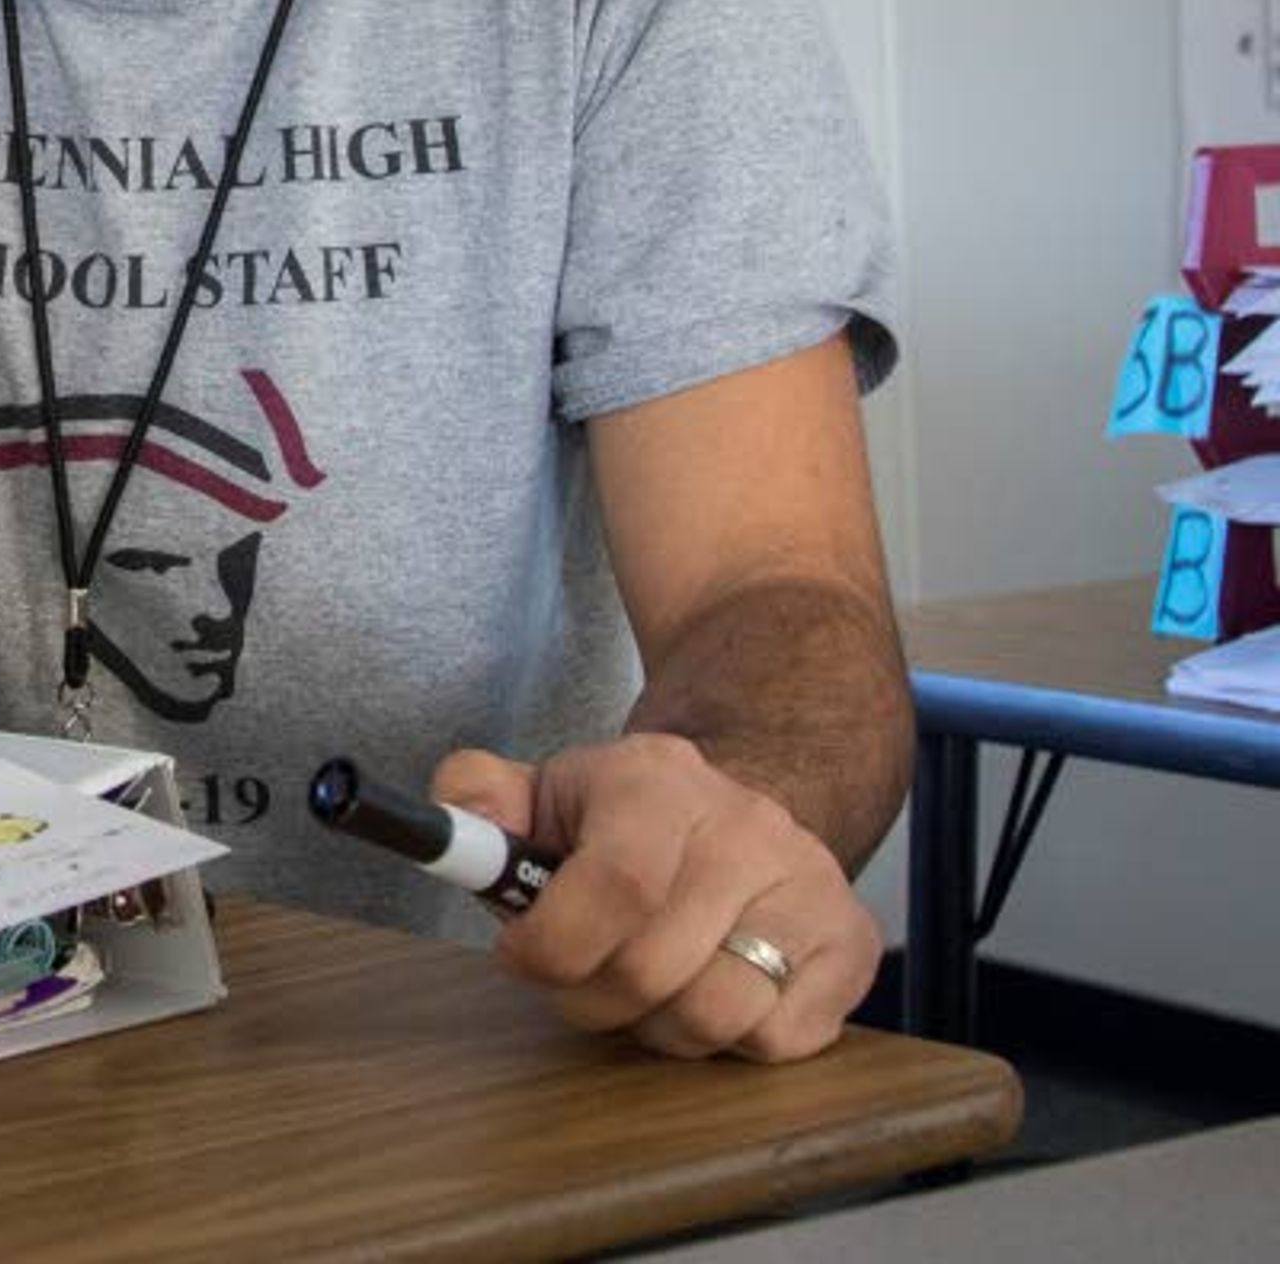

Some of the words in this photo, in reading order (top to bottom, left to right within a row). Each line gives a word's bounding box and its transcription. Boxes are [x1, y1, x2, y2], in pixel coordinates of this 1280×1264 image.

[276, 115, 467, 184] HIGH
[186, 241, 402, 310] STAFF
[179, 774, 272, 826] -19
